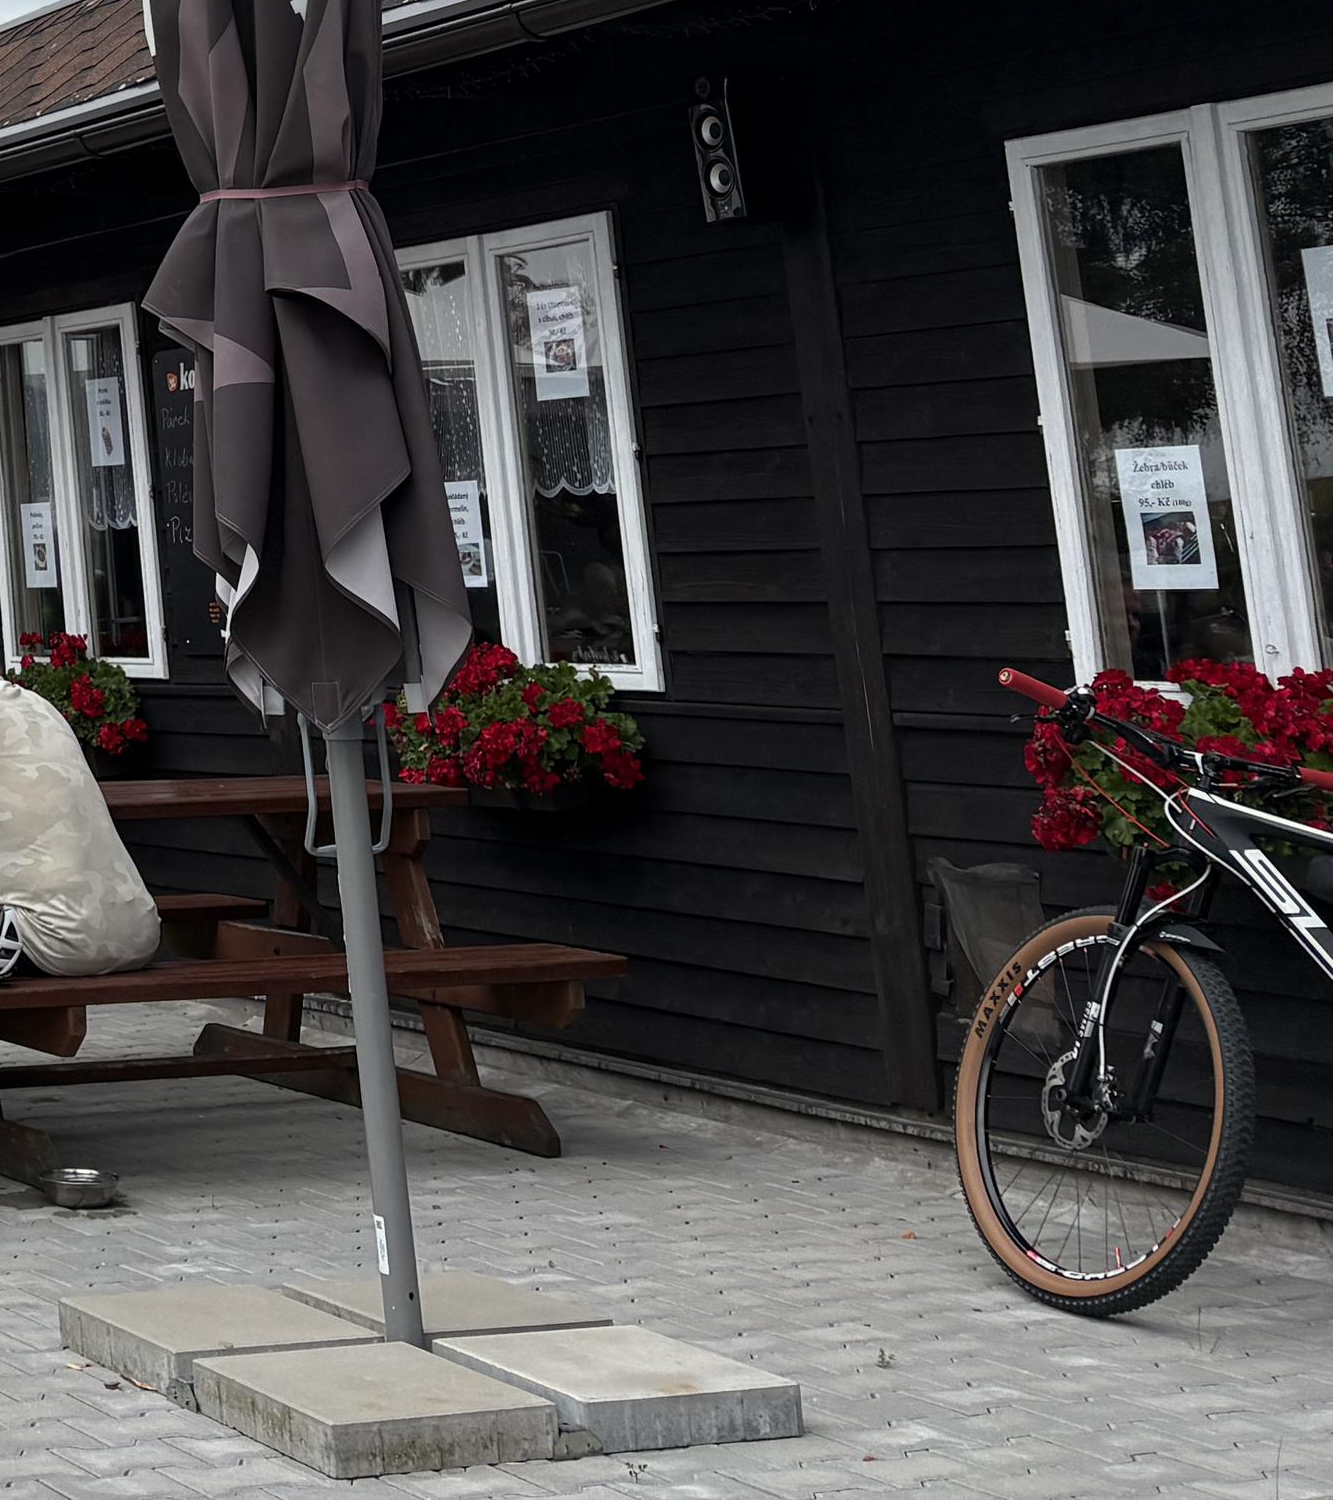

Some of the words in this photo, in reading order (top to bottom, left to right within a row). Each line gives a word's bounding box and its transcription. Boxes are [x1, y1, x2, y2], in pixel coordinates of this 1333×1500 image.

[1150, 479, 1175, 490] chléb
[1157, 497, 1171, 507] Kč
[974, 961, 1024, 1040] MAXXIS
